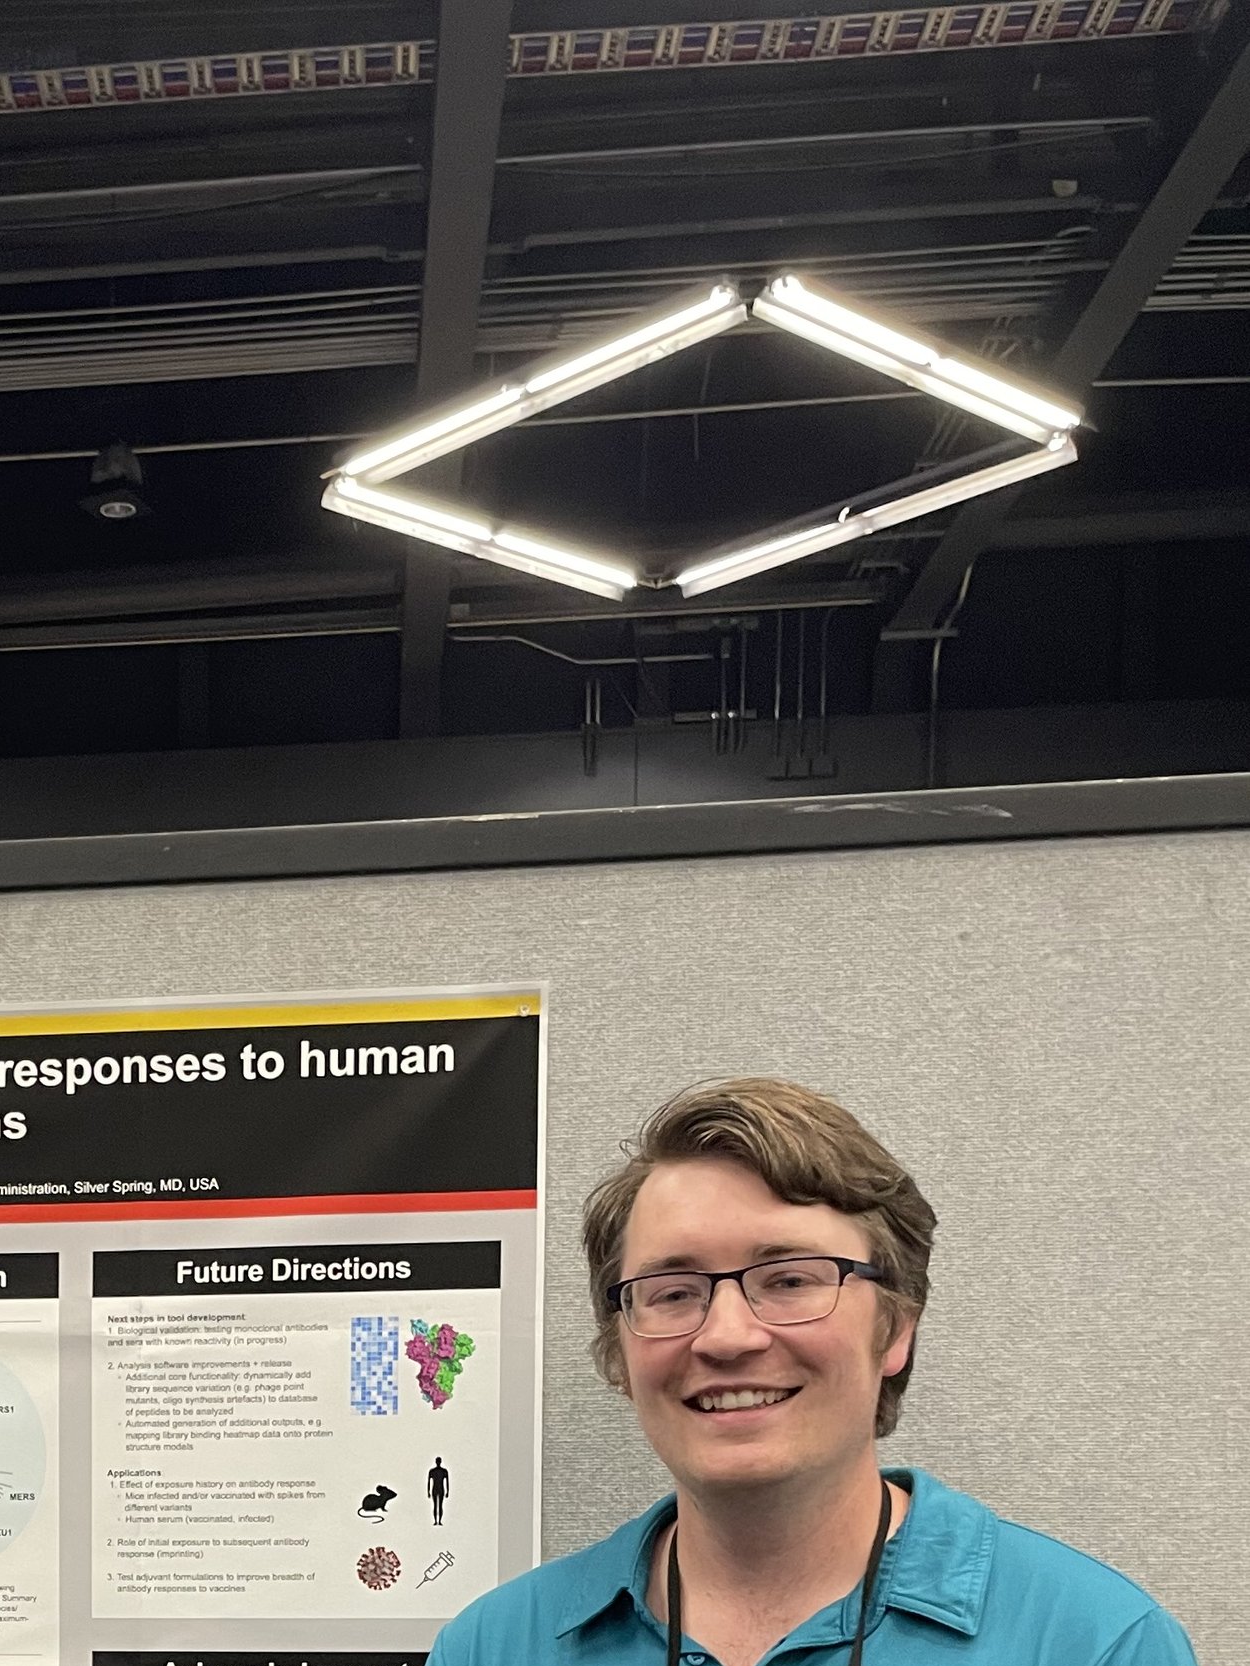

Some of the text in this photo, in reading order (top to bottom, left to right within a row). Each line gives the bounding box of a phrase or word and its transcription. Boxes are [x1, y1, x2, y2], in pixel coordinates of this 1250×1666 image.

[240, 1044, 284, 1080] to
[301, 1040, 454, 1077] human
[74, 1181, 109, 1193] Silver
[112, 1180, 156, 1194] Spring,
[160, 1178, 185, 1192] MD,
[190, 1178, 219, 1190] USA
[177, 1257, 410, 1283] Future Directions
